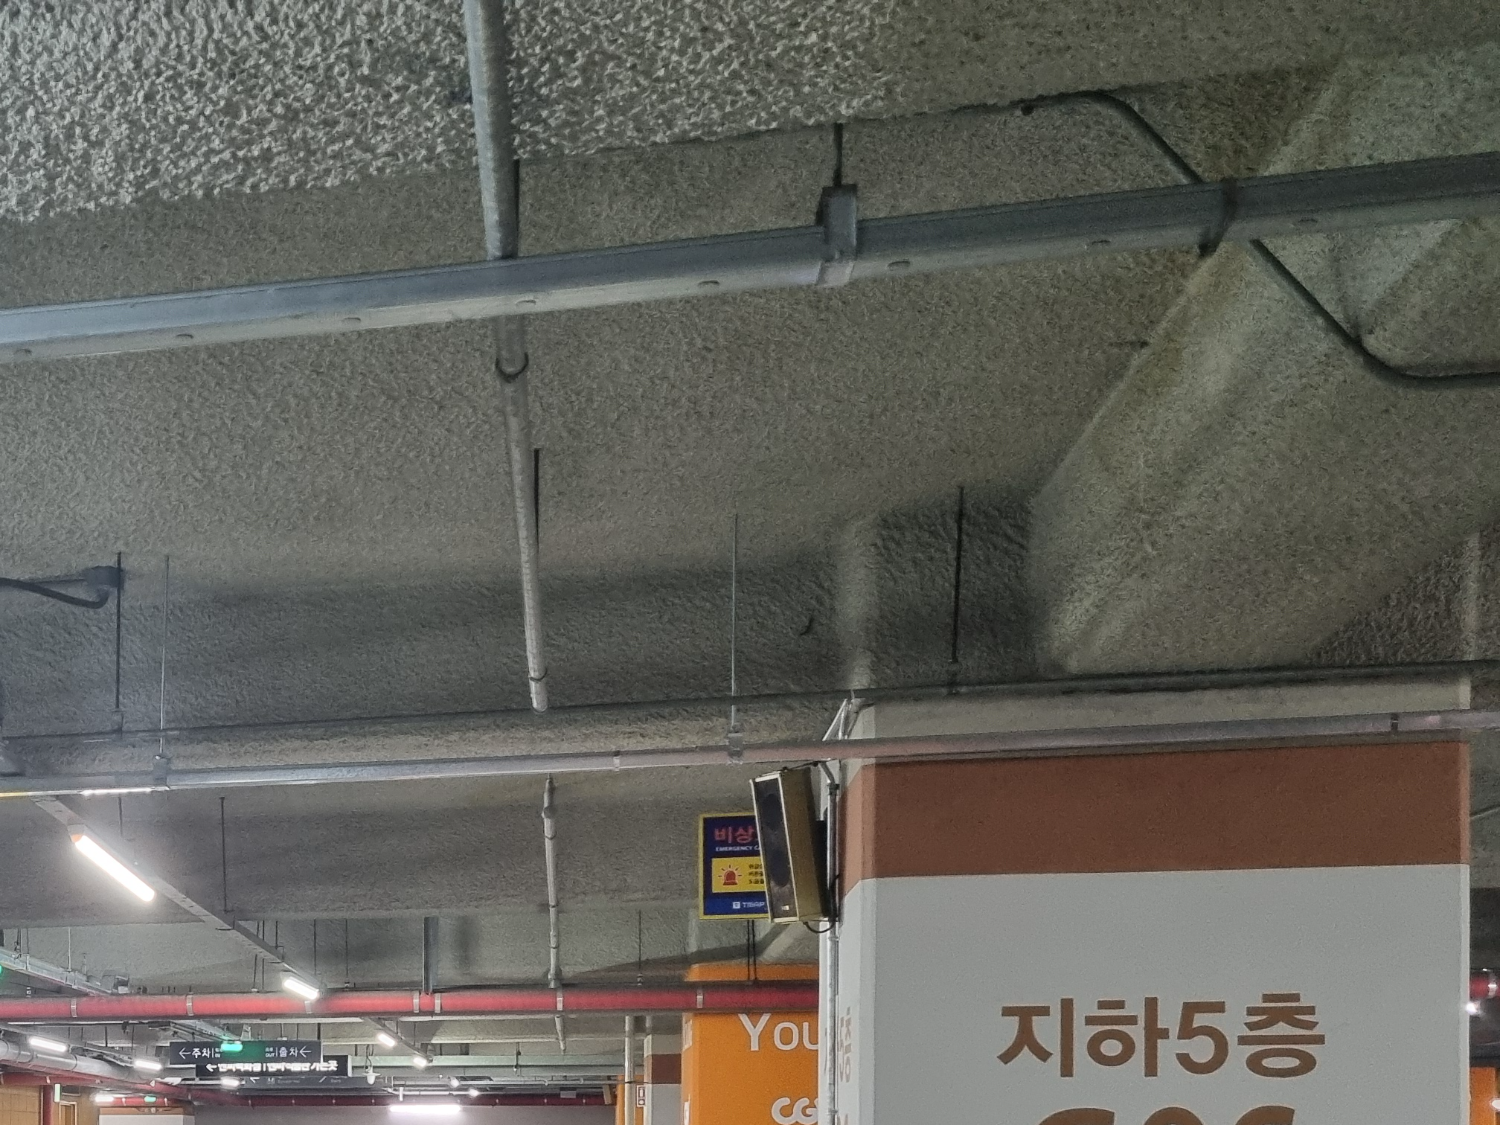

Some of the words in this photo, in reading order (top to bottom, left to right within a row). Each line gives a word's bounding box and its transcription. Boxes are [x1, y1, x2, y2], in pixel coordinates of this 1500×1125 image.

[714, 826, 758, 843] 비상
[738, 1013, 819, 1051] You
[996, 993, 1325, 1078] 지하5층
[191, 1047, 210, 1059] 주차
[771, 1097, 819, 1125] CG
